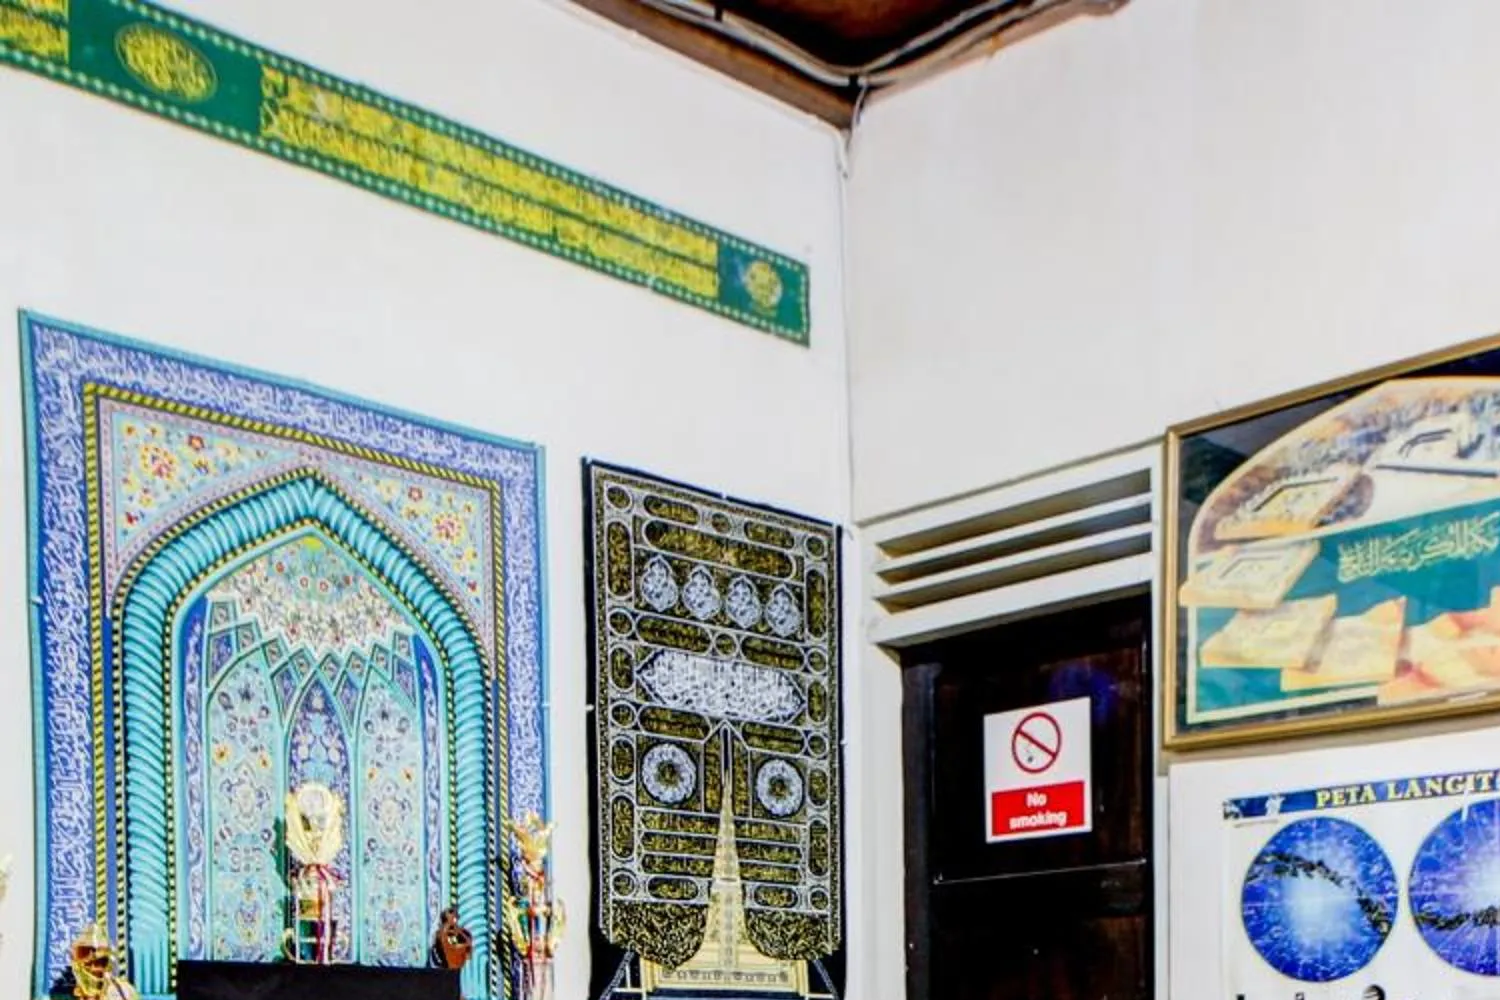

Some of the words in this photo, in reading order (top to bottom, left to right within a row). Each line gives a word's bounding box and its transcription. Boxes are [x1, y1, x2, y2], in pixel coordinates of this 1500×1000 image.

[1315, 784, 1377, 809] PETA
[1386, 771, 1493, 801] LANGIT
[1026, 792, 1048, 807] No
[1009, 811, 1067, 829] smoking
